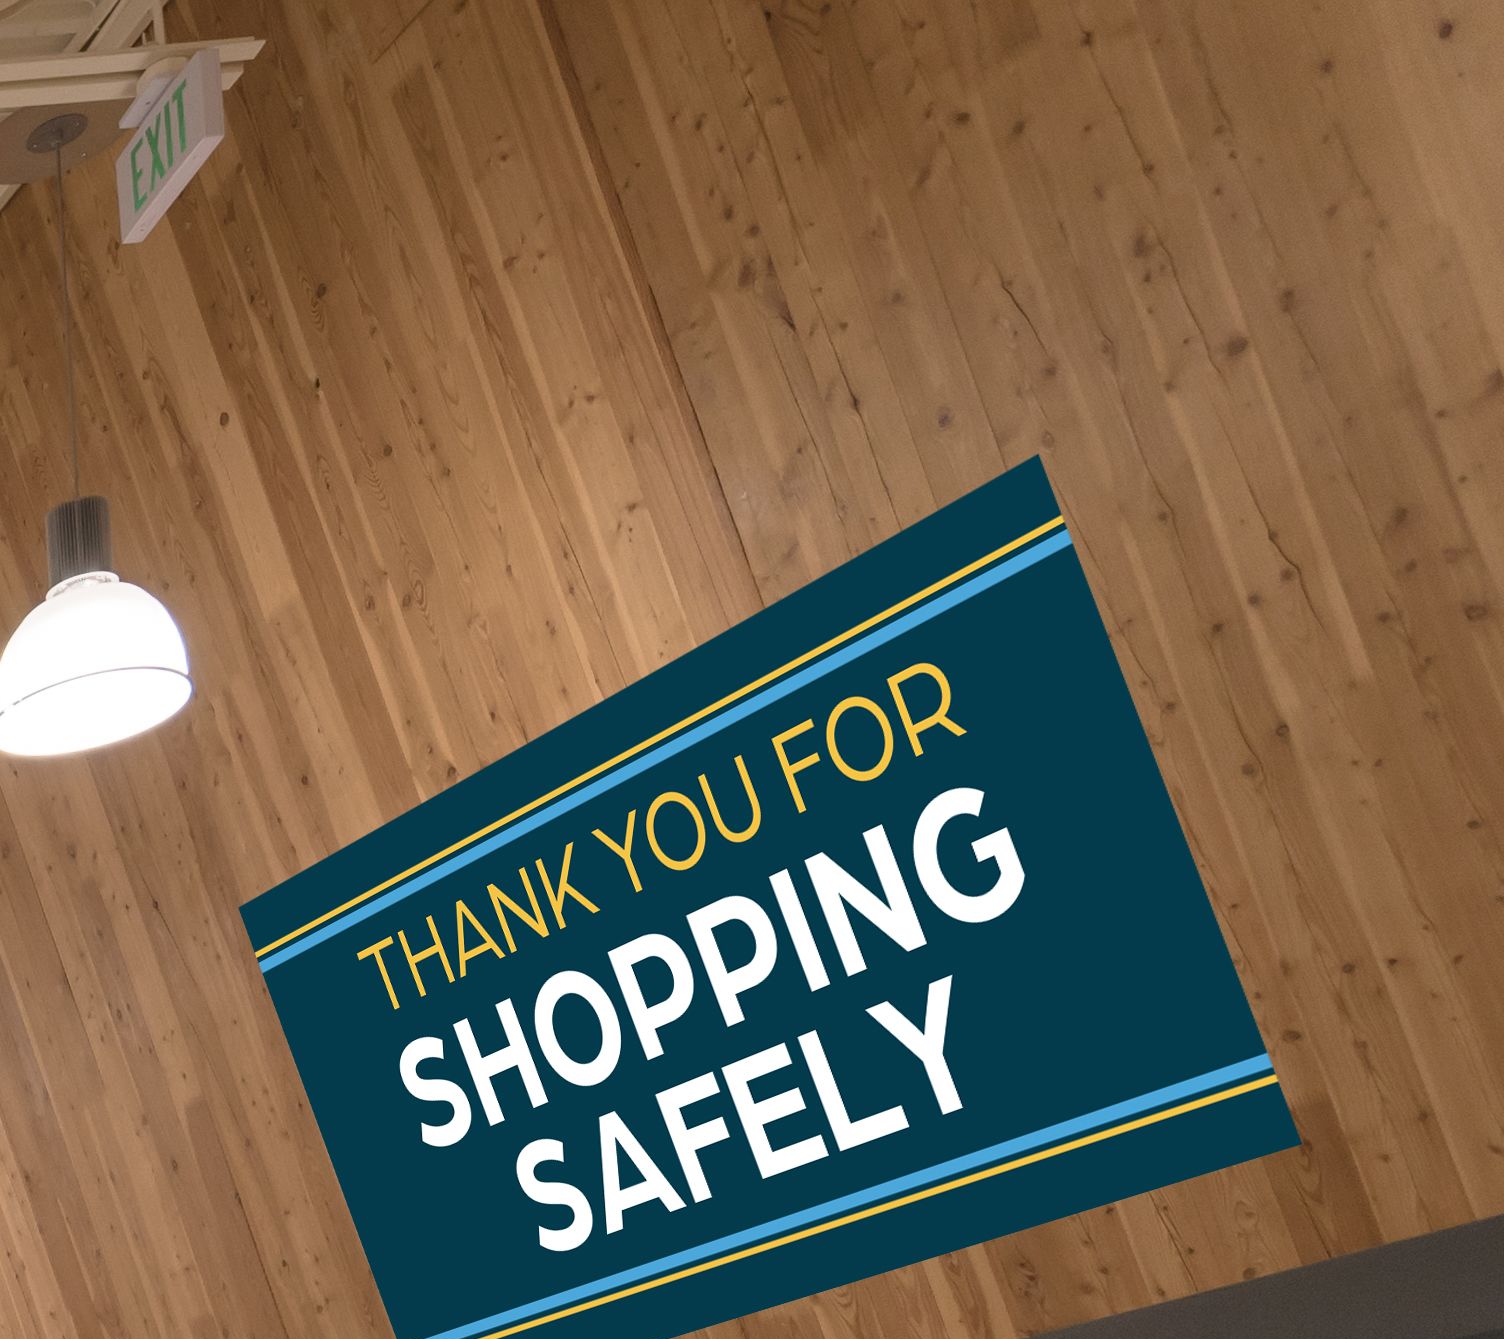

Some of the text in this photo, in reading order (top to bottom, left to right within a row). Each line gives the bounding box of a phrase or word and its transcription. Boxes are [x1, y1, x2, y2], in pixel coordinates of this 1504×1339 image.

[130, 78, 187, 212] EXIT
[356, 661, 968, 1011] THANK YOU FOR
[396, 785, 1028, 1147] SHOPPING
[514, 973, 964, 1253] SAFELY
